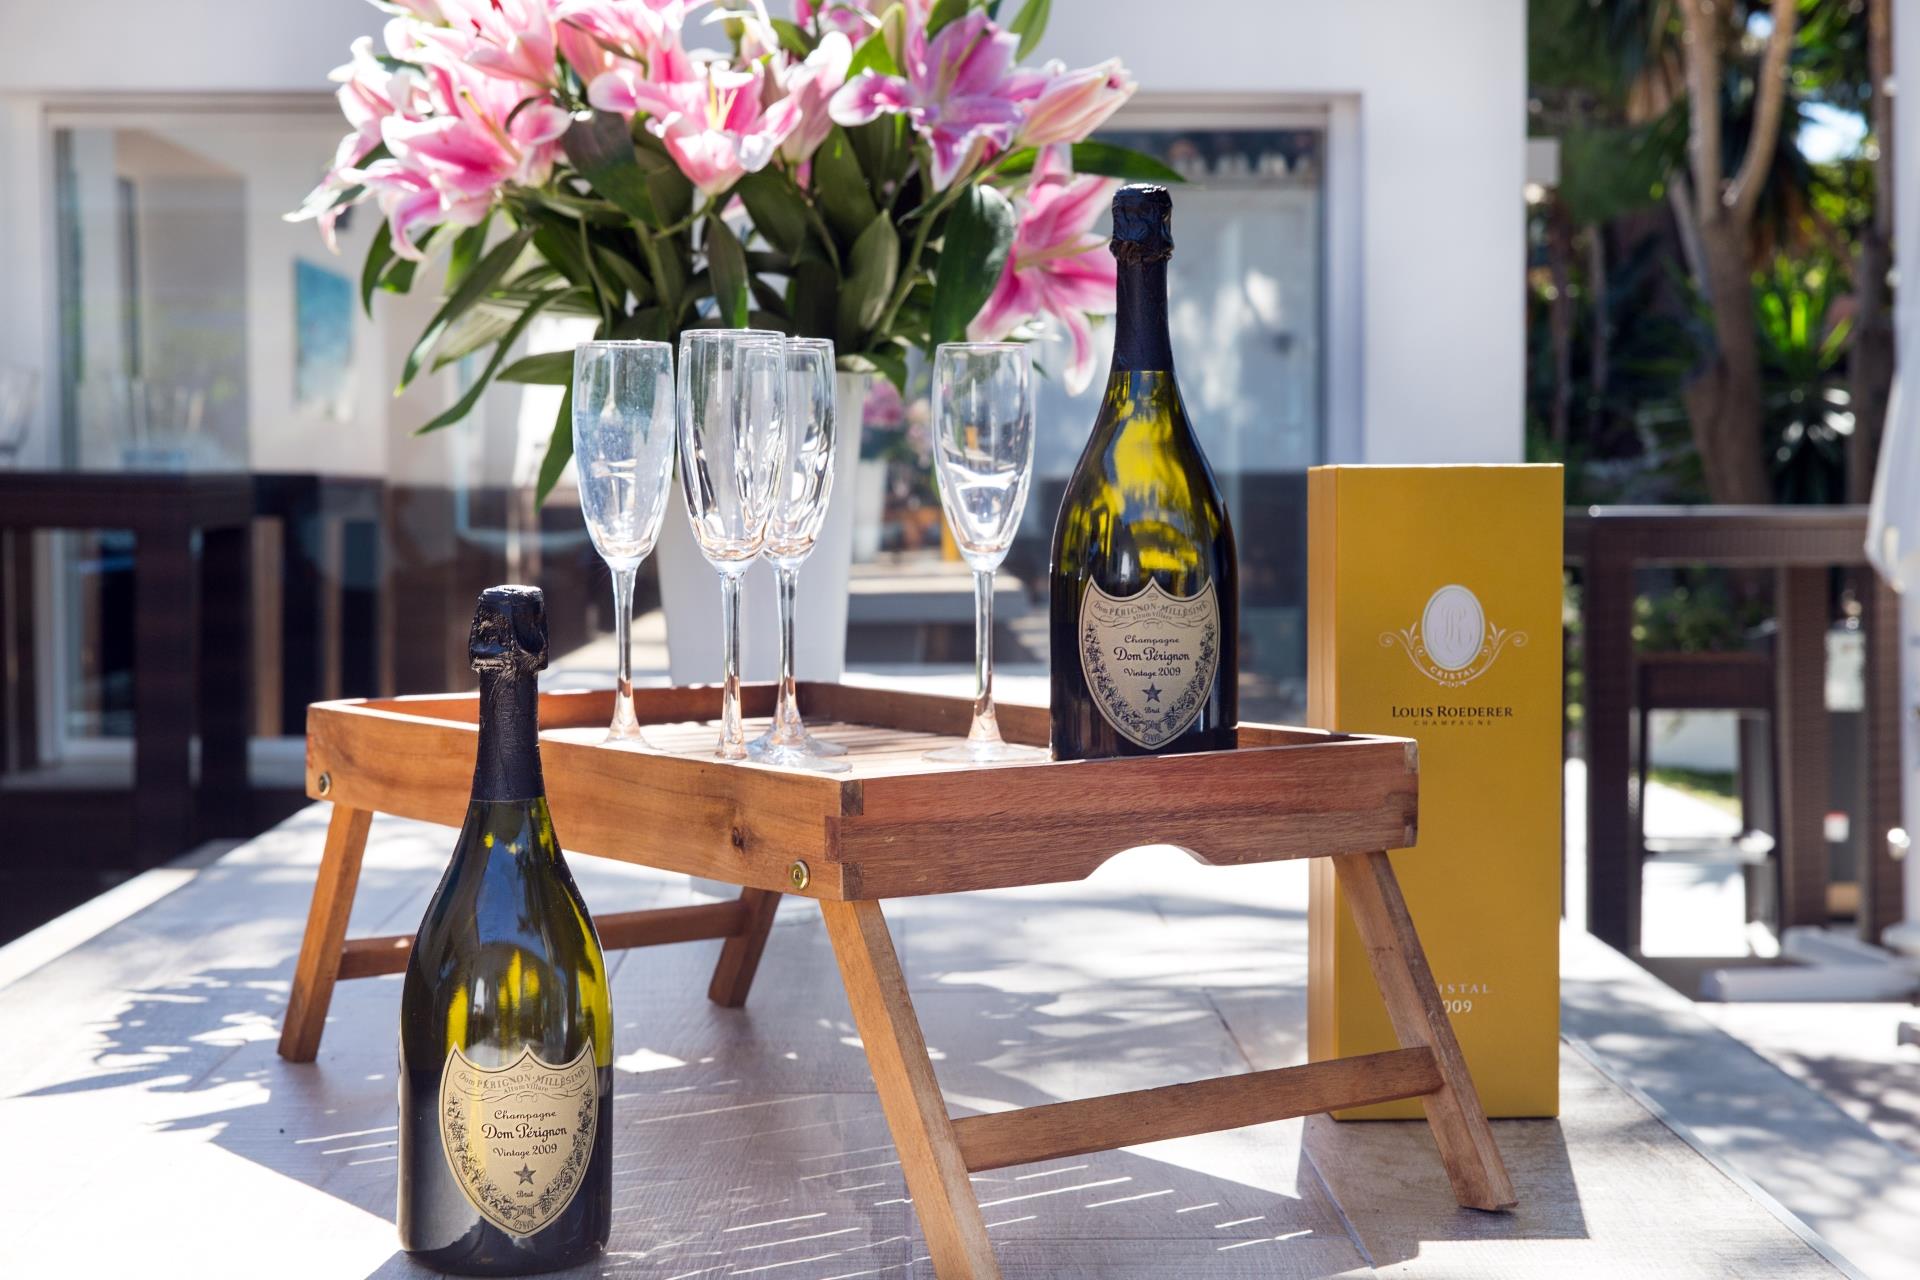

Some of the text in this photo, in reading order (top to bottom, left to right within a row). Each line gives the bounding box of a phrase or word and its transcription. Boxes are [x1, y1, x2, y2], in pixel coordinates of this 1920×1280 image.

[1124, 634, 1180, 647] Champagne
[1113, 646, 1190, 665] Dom Pérignon
[1123, 667, 1181, 680] Vintage 2009
[1429, 665, 1476, 680] CRISTAL
[1392, 705, 1513, 718] LOUIS ROEDERER
[1413, 719, 1493, 727] CHAMPAGNE
[1439, 983, 1489, 994] ISTAL
[1442, 999, 1473, 1014] 009
[459, 1072, 475, 1087] Dom
[494, 1109, 557, 1122] Champagne
[481, 1123, 568, 1142] Dom Pérignon
[493, 1143, 558, 1159] Vintage 2009
[516, 1190, 534, 1198] Brut
